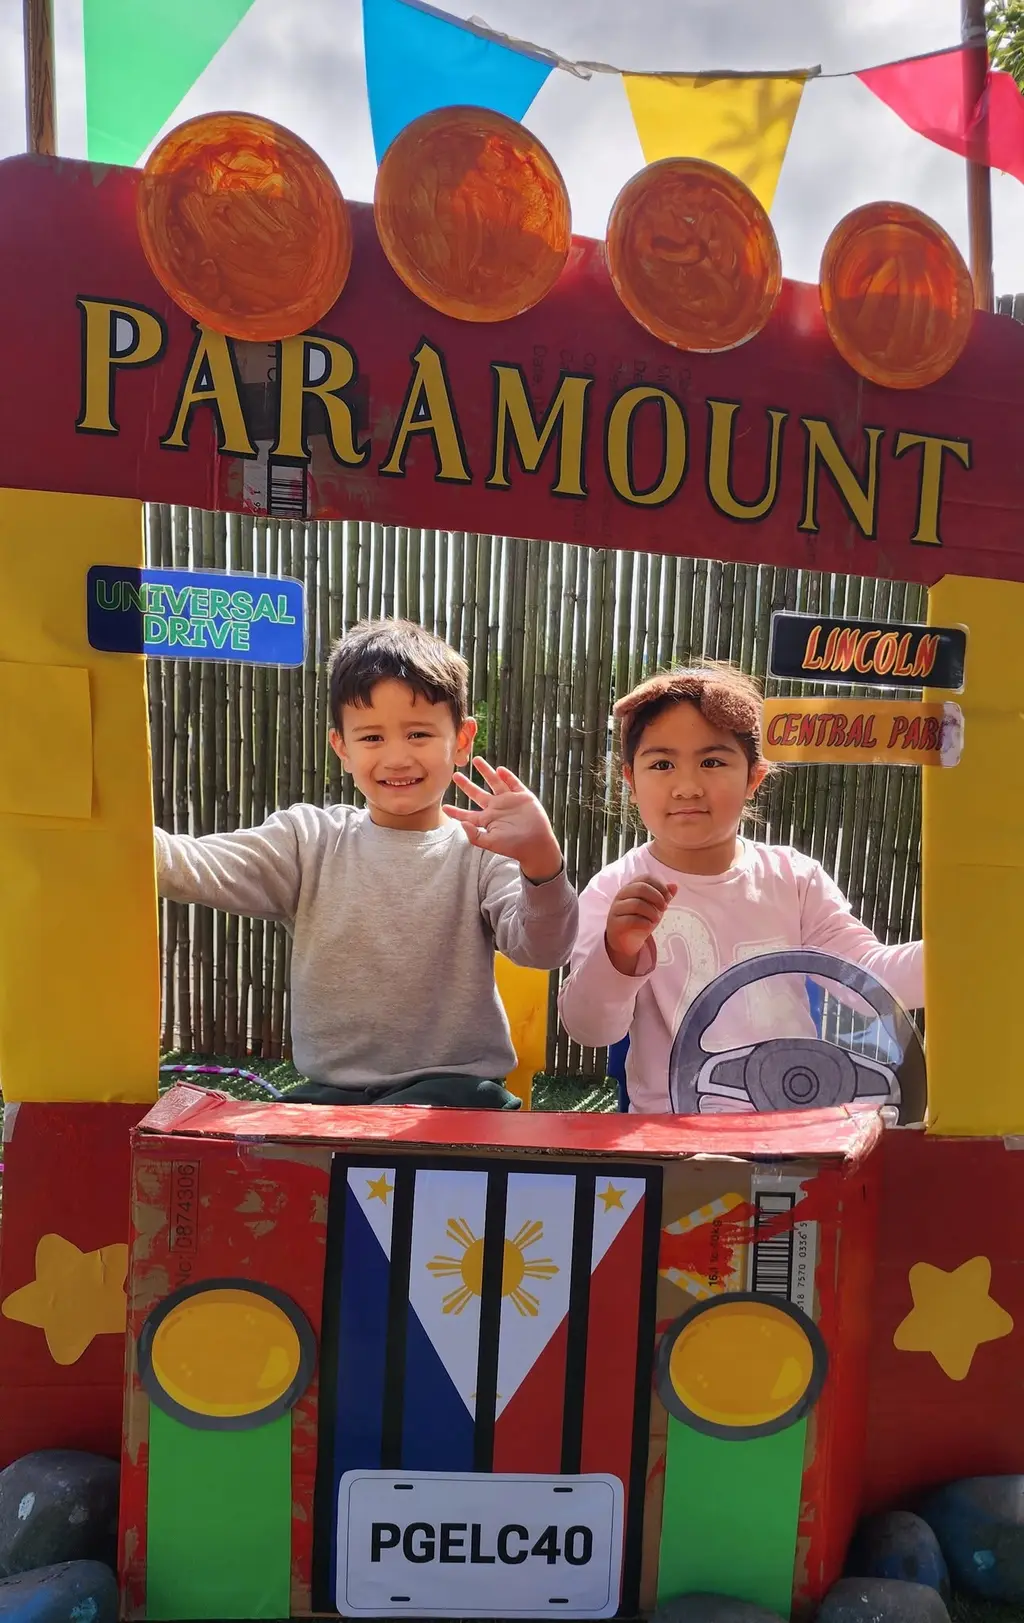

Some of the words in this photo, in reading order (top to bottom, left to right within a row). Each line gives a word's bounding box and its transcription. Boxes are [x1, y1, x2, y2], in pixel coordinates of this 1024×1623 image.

[76, 295, 972, 546] PARAMOUNT
[96, 579, 296, 625] UNIVERSAL
[143, 613, 250, 651] DRIVE
[801, 624, 941, 678] LINCOLN
[766, 712, 878, 748] CENTRAL
[175, 1164, 195, 1249] 0874306
[798, 1233, 807, 1257] 0336
[797, 1263, 806, 1287] 7570
[370, 1521, 594, 1566] PGELC40
